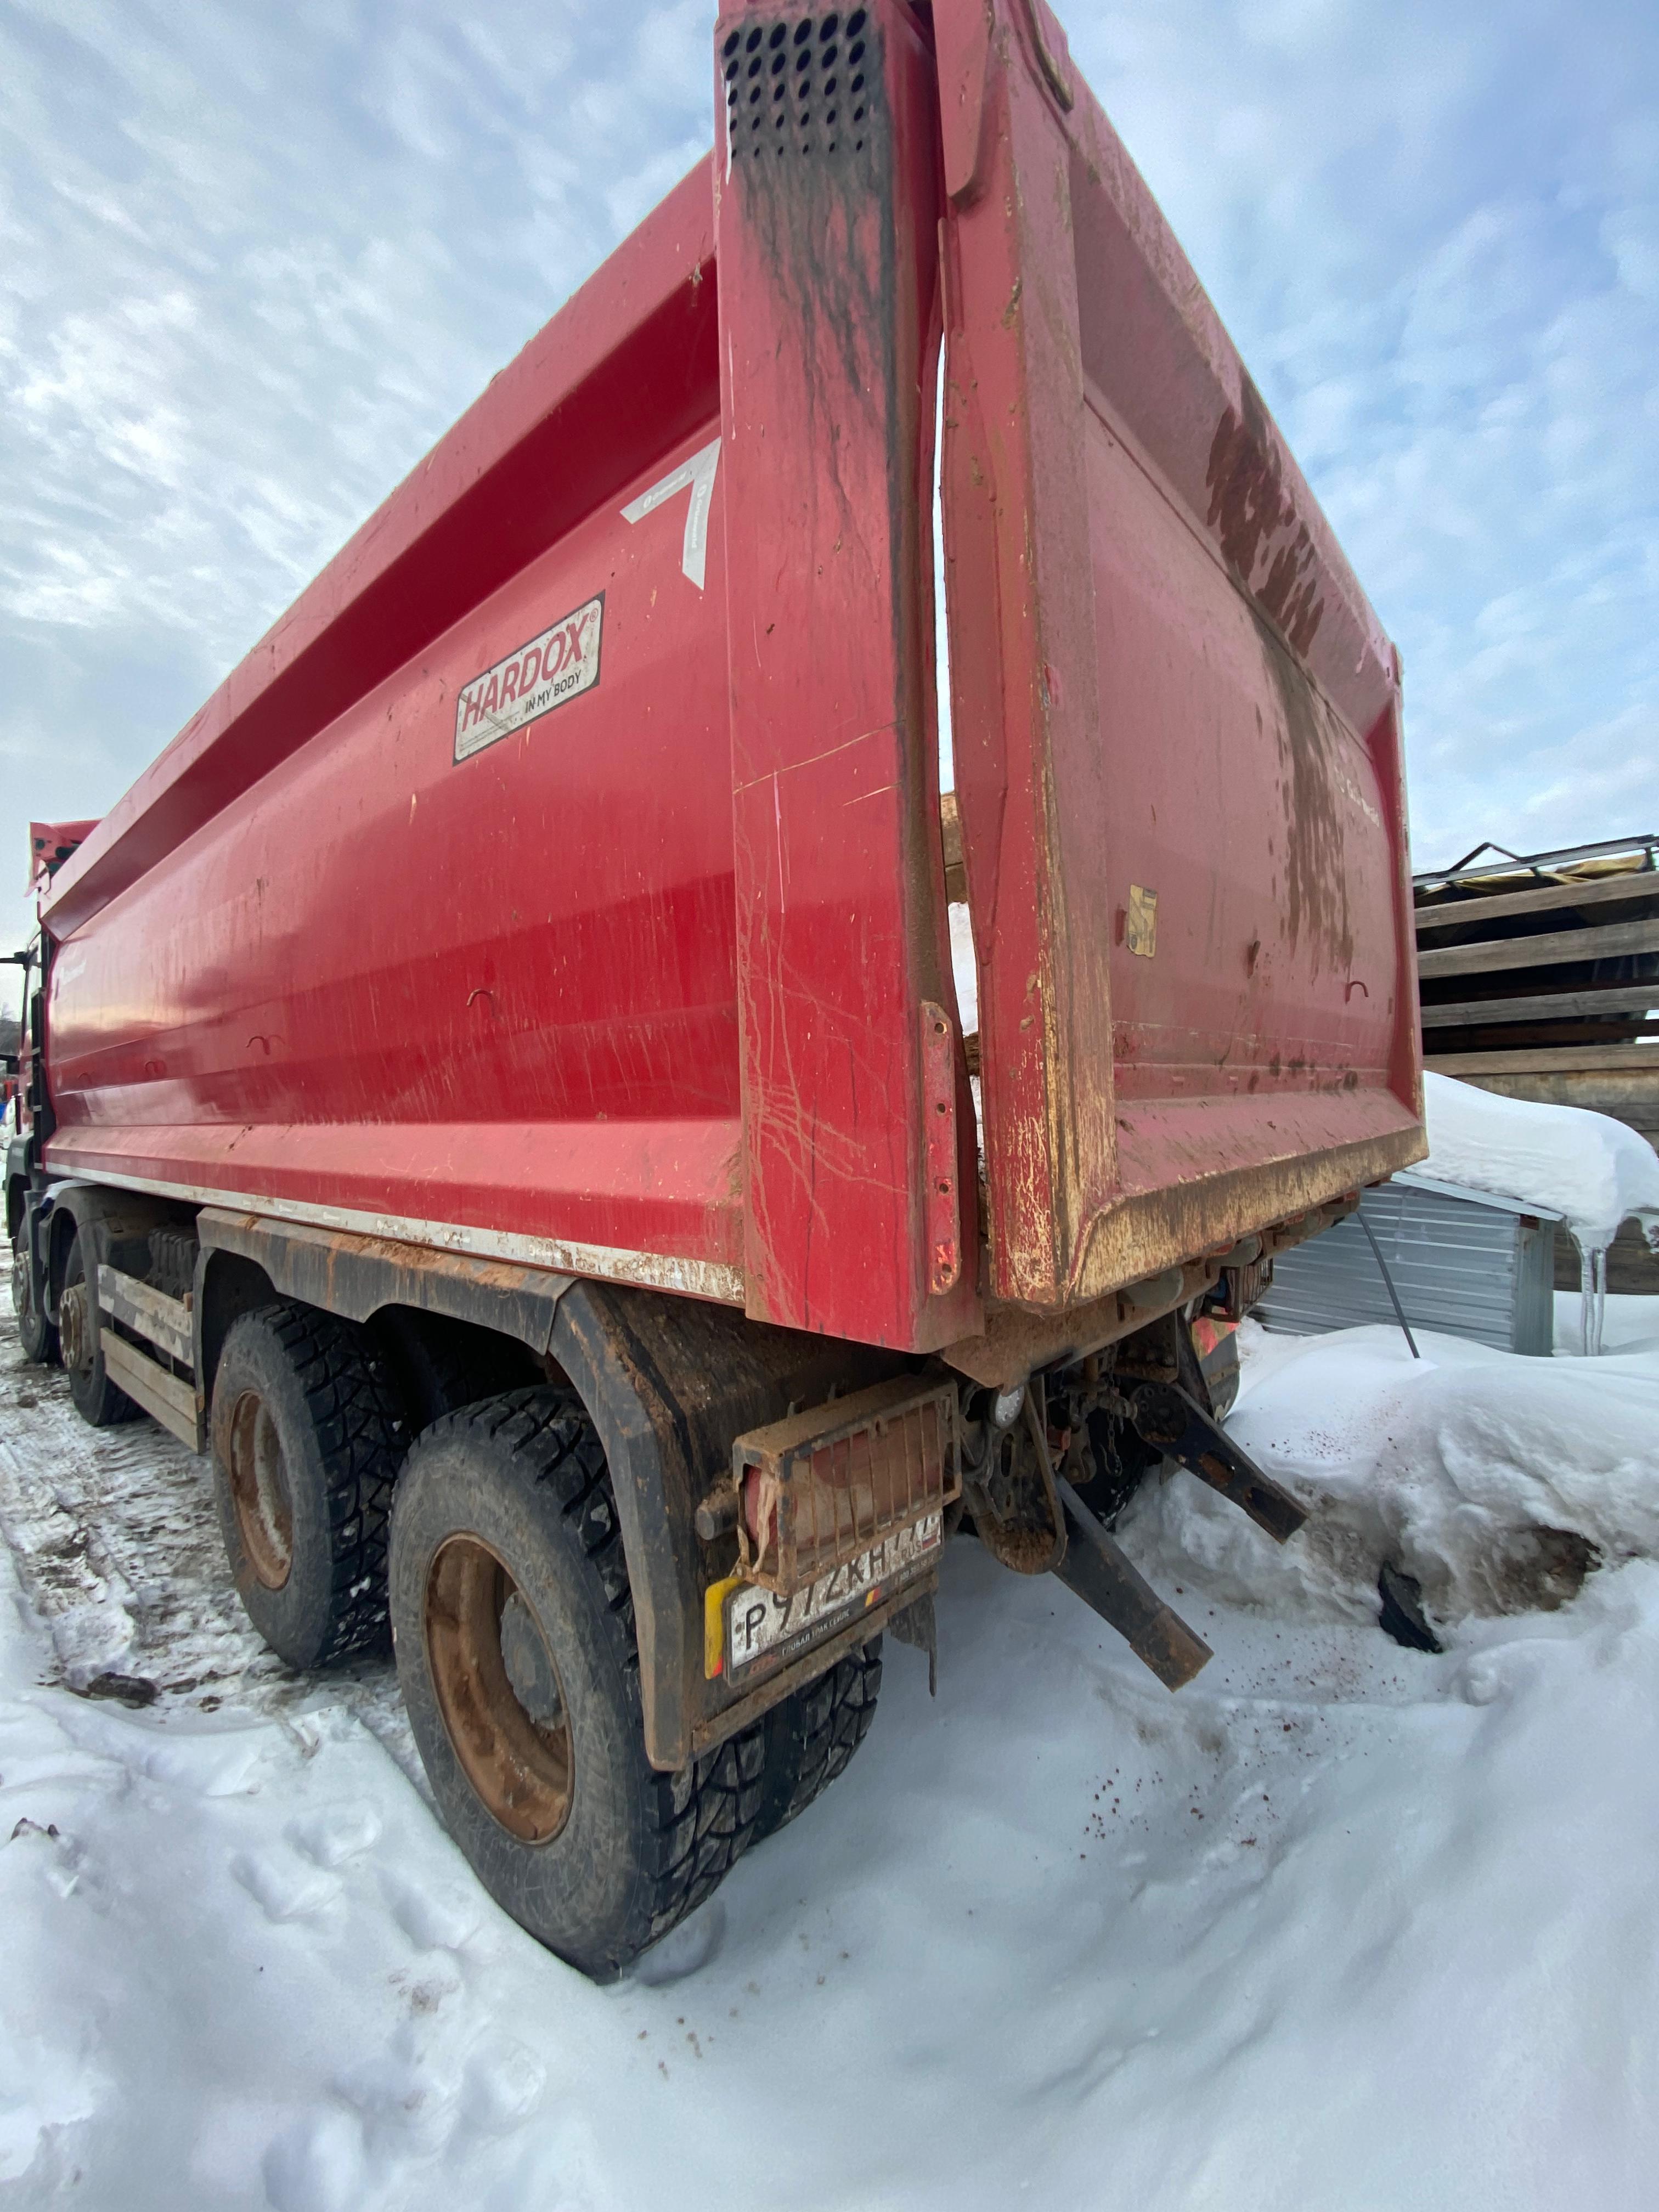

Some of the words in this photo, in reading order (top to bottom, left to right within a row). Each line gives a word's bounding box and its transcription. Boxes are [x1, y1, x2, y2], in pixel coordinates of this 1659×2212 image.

[461, 613, 589, 732] HARDOX
[525, 699, 536, 713] IN
[537, 687, 552, 708] MY
[554, 669, 582, 697] BODY
